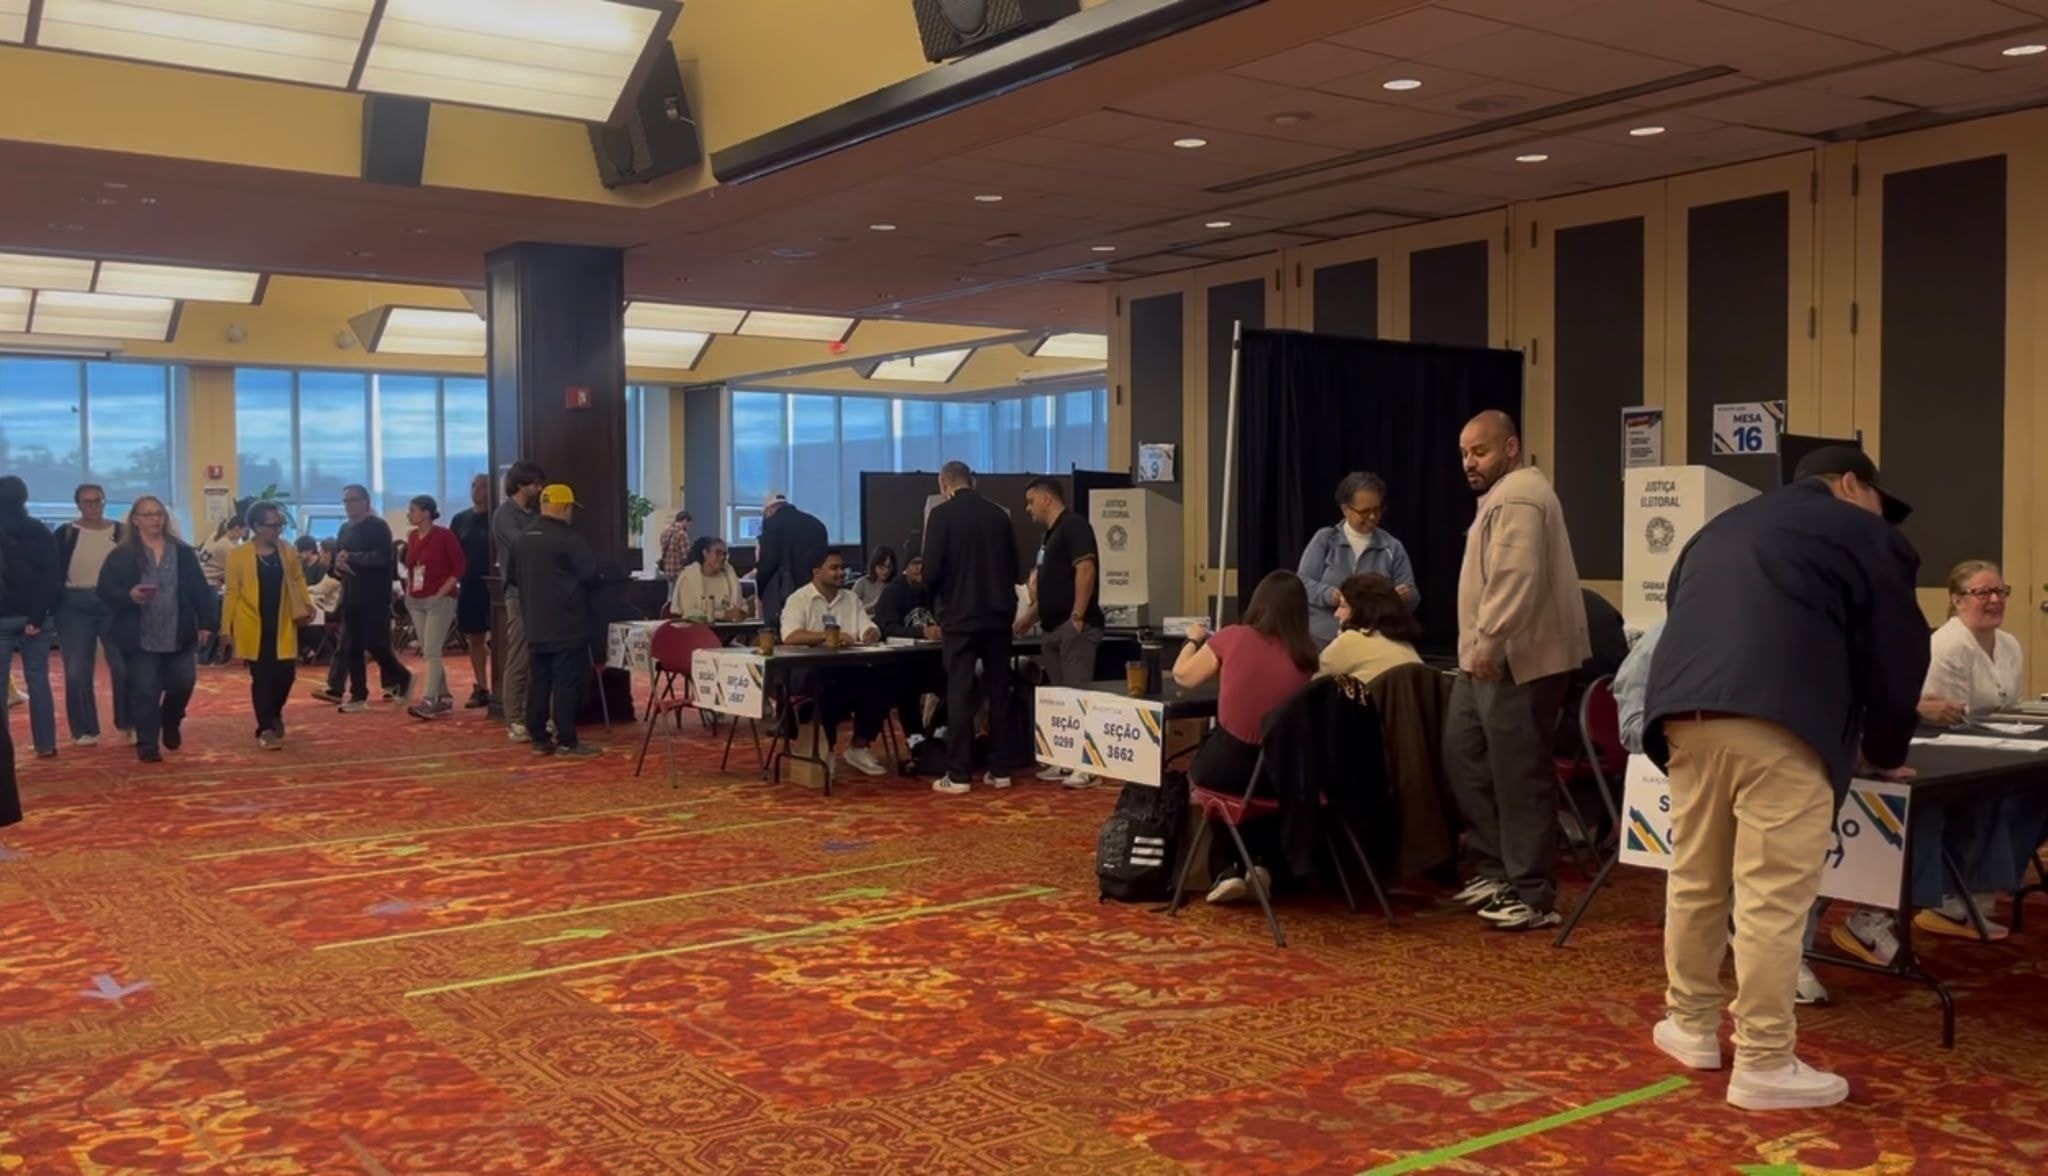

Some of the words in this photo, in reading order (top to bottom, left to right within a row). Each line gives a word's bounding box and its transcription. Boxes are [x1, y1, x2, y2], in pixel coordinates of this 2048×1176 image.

[1733, 413, 1762, 423] MESA
[1733, 426, 1762, 452] 16
[1151, 461, 1160, 479] 9
[1645, 481, 1676, 492] JUSTIÇA
[1640, 496, 1680, 508] ELEITORAL
[1051, 715, 1080, 732] SEÇÃO
[1103, 722, 1140, 742] SEÇÃO
[1053, 735, 1074, 750] 0299
[1107, 745, 1134, 762] 3662
